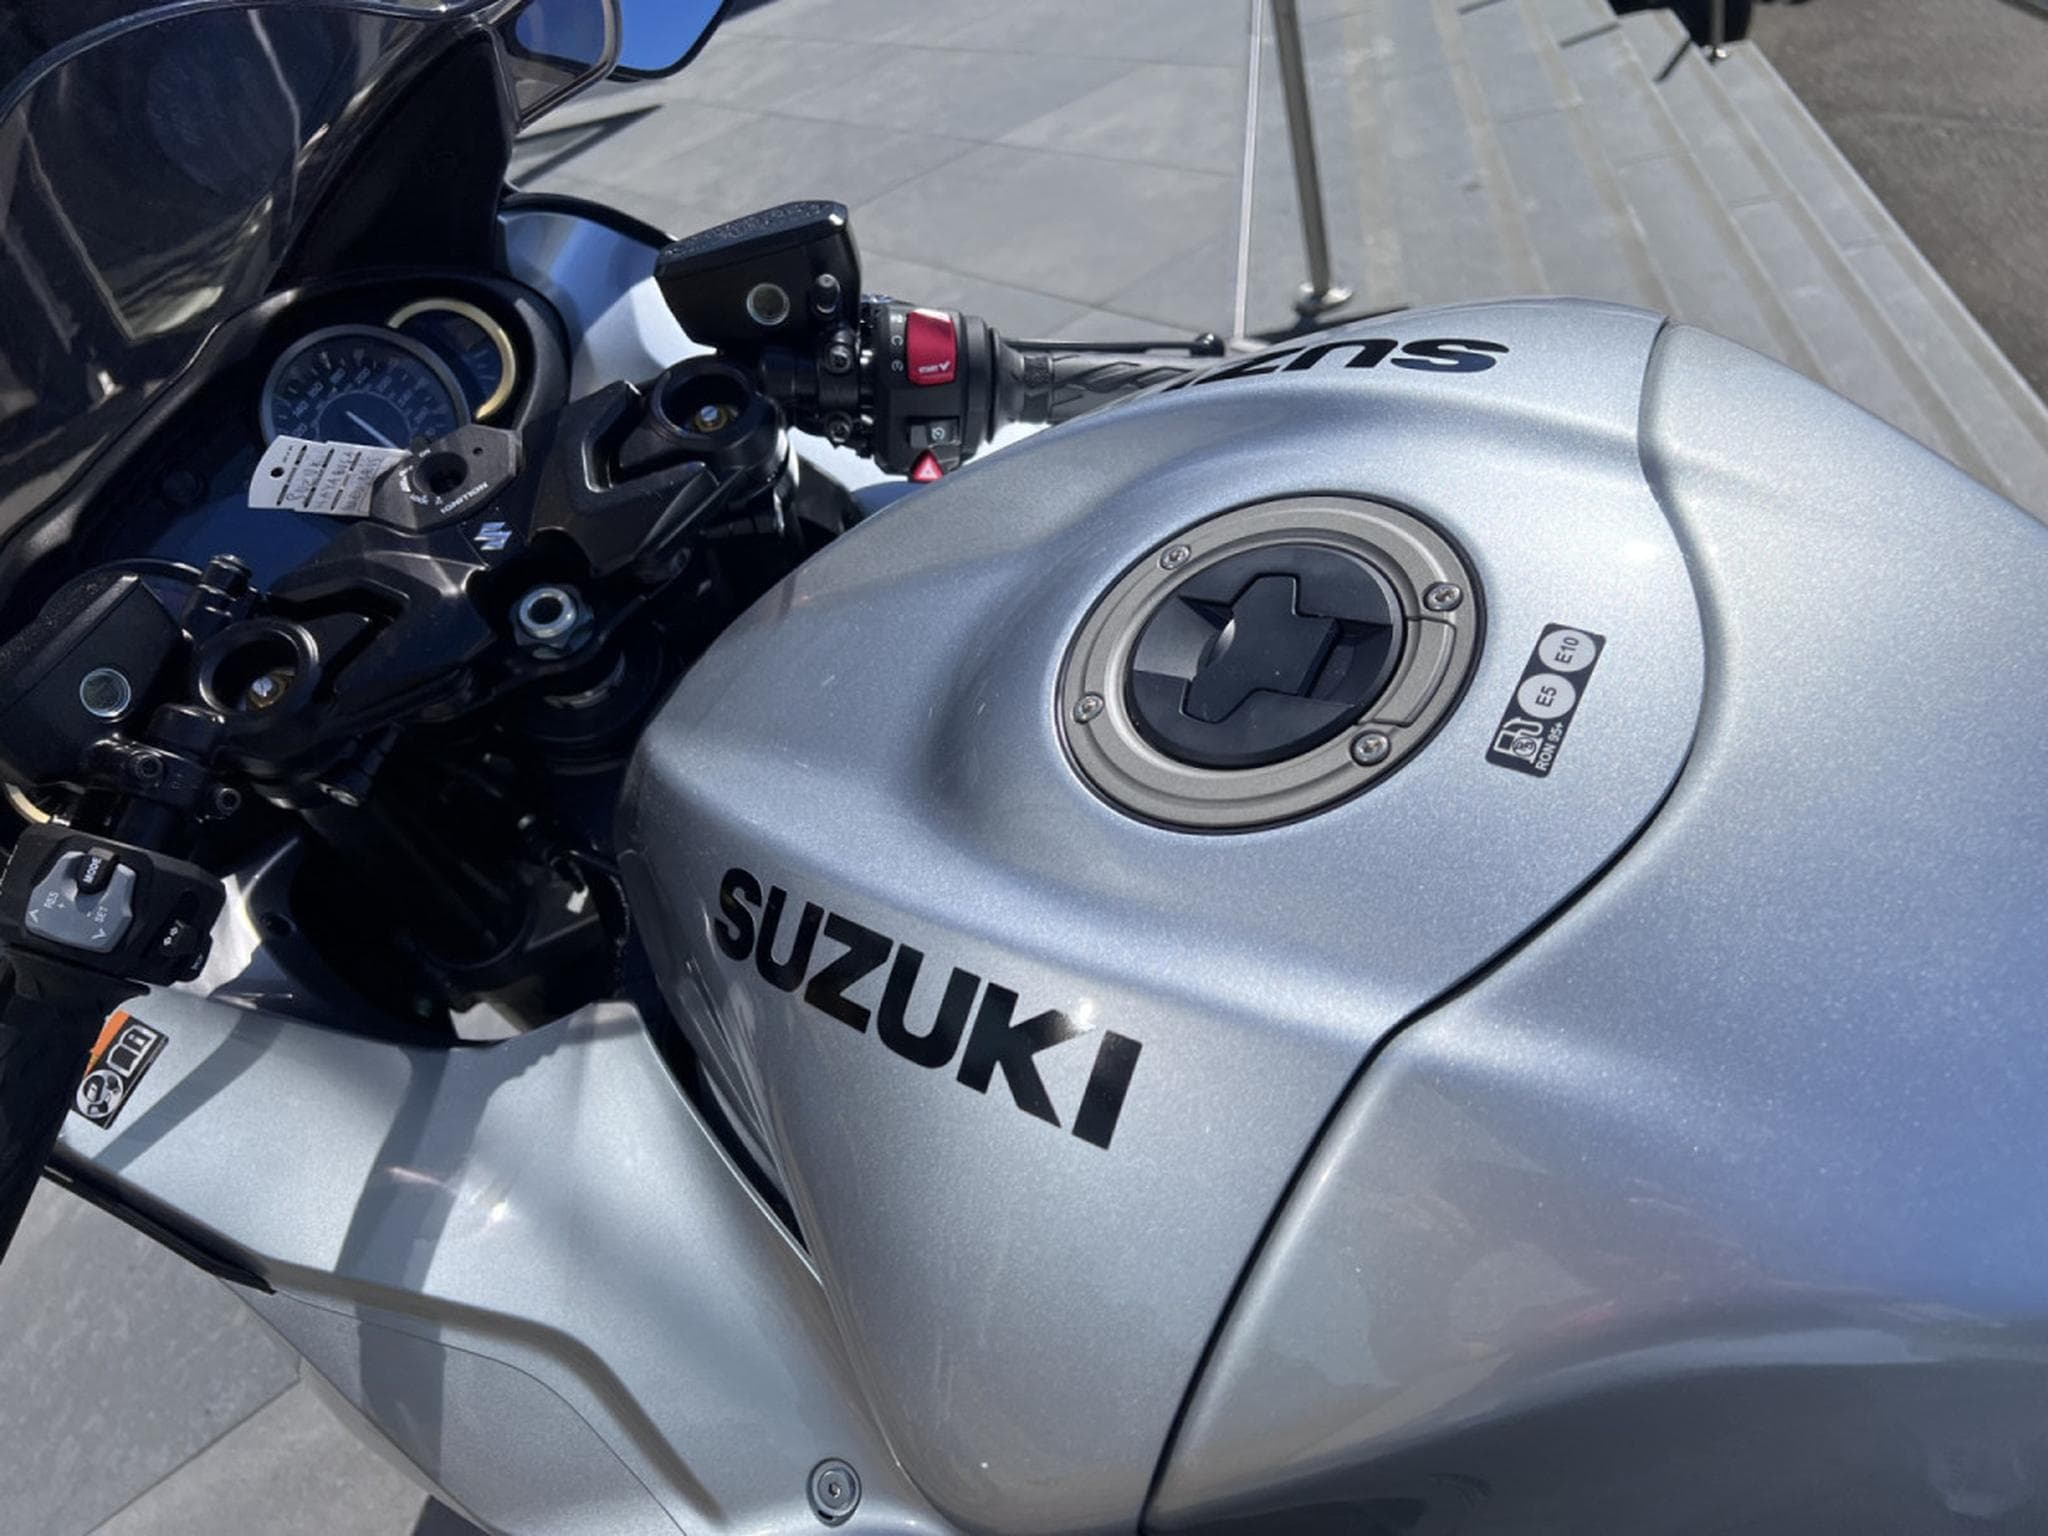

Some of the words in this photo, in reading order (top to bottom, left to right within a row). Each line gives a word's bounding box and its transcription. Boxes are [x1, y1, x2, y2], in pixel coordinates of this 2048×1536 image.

[440, 481, 488, 514] IGNITION
[1554, 636, 1580, 665] E10
[1534, 685, 1557, 708] E5
[1535, 743, 1557, 771] RON
[82, 856, 102, 884] MODE
[713, 867, 1144, 1151] SUZUKI
